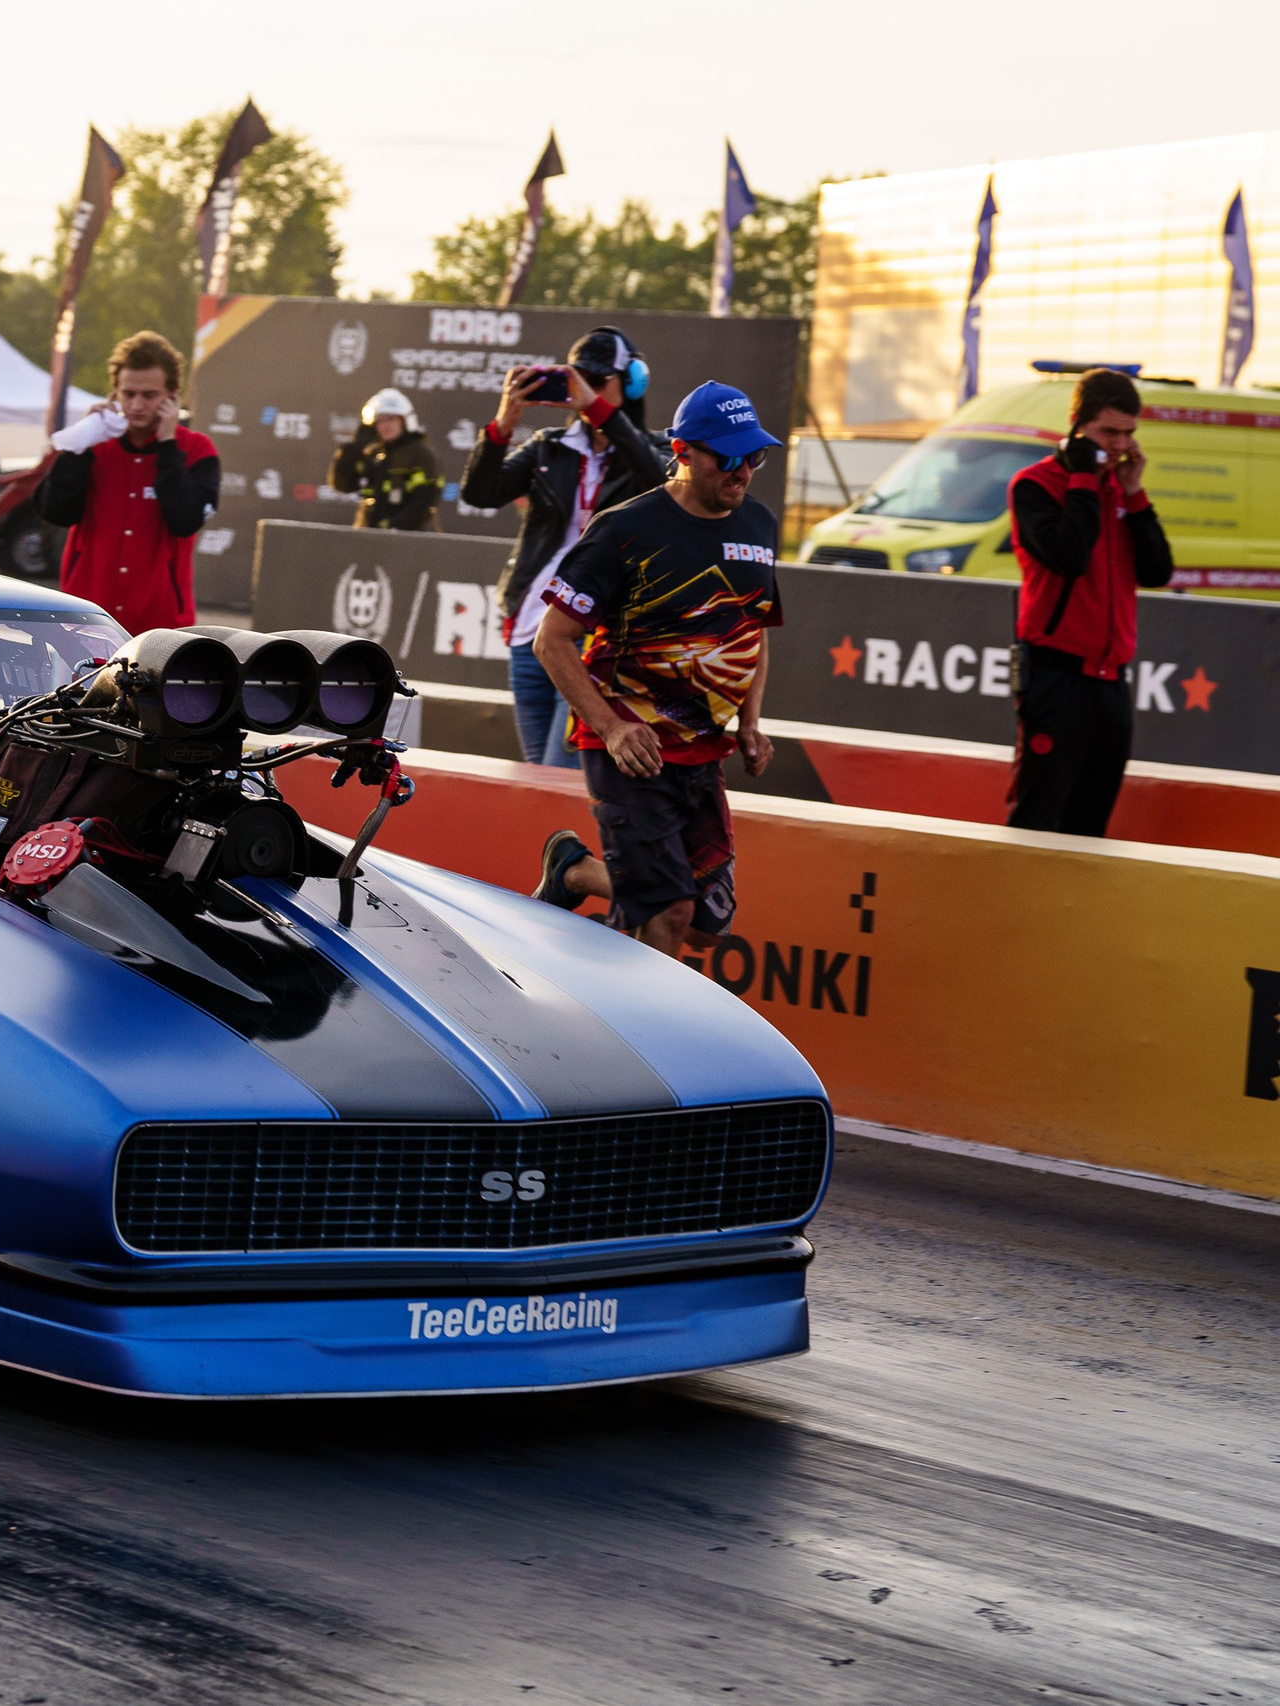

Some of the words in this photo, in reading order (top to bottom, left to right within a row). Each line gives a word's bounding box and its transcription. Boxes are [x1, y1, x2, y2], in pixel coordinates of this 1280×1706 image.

[429, 308, 522, 347] RDRC
[727, 411, 756, 425] TIME
[722, 542, 774, 567] RDRC
[17, 842, 68, 860] MSD
[479, 1169, 547, 1203] SS
[407, 1291, 618, 1340] TeeCeeRacing
